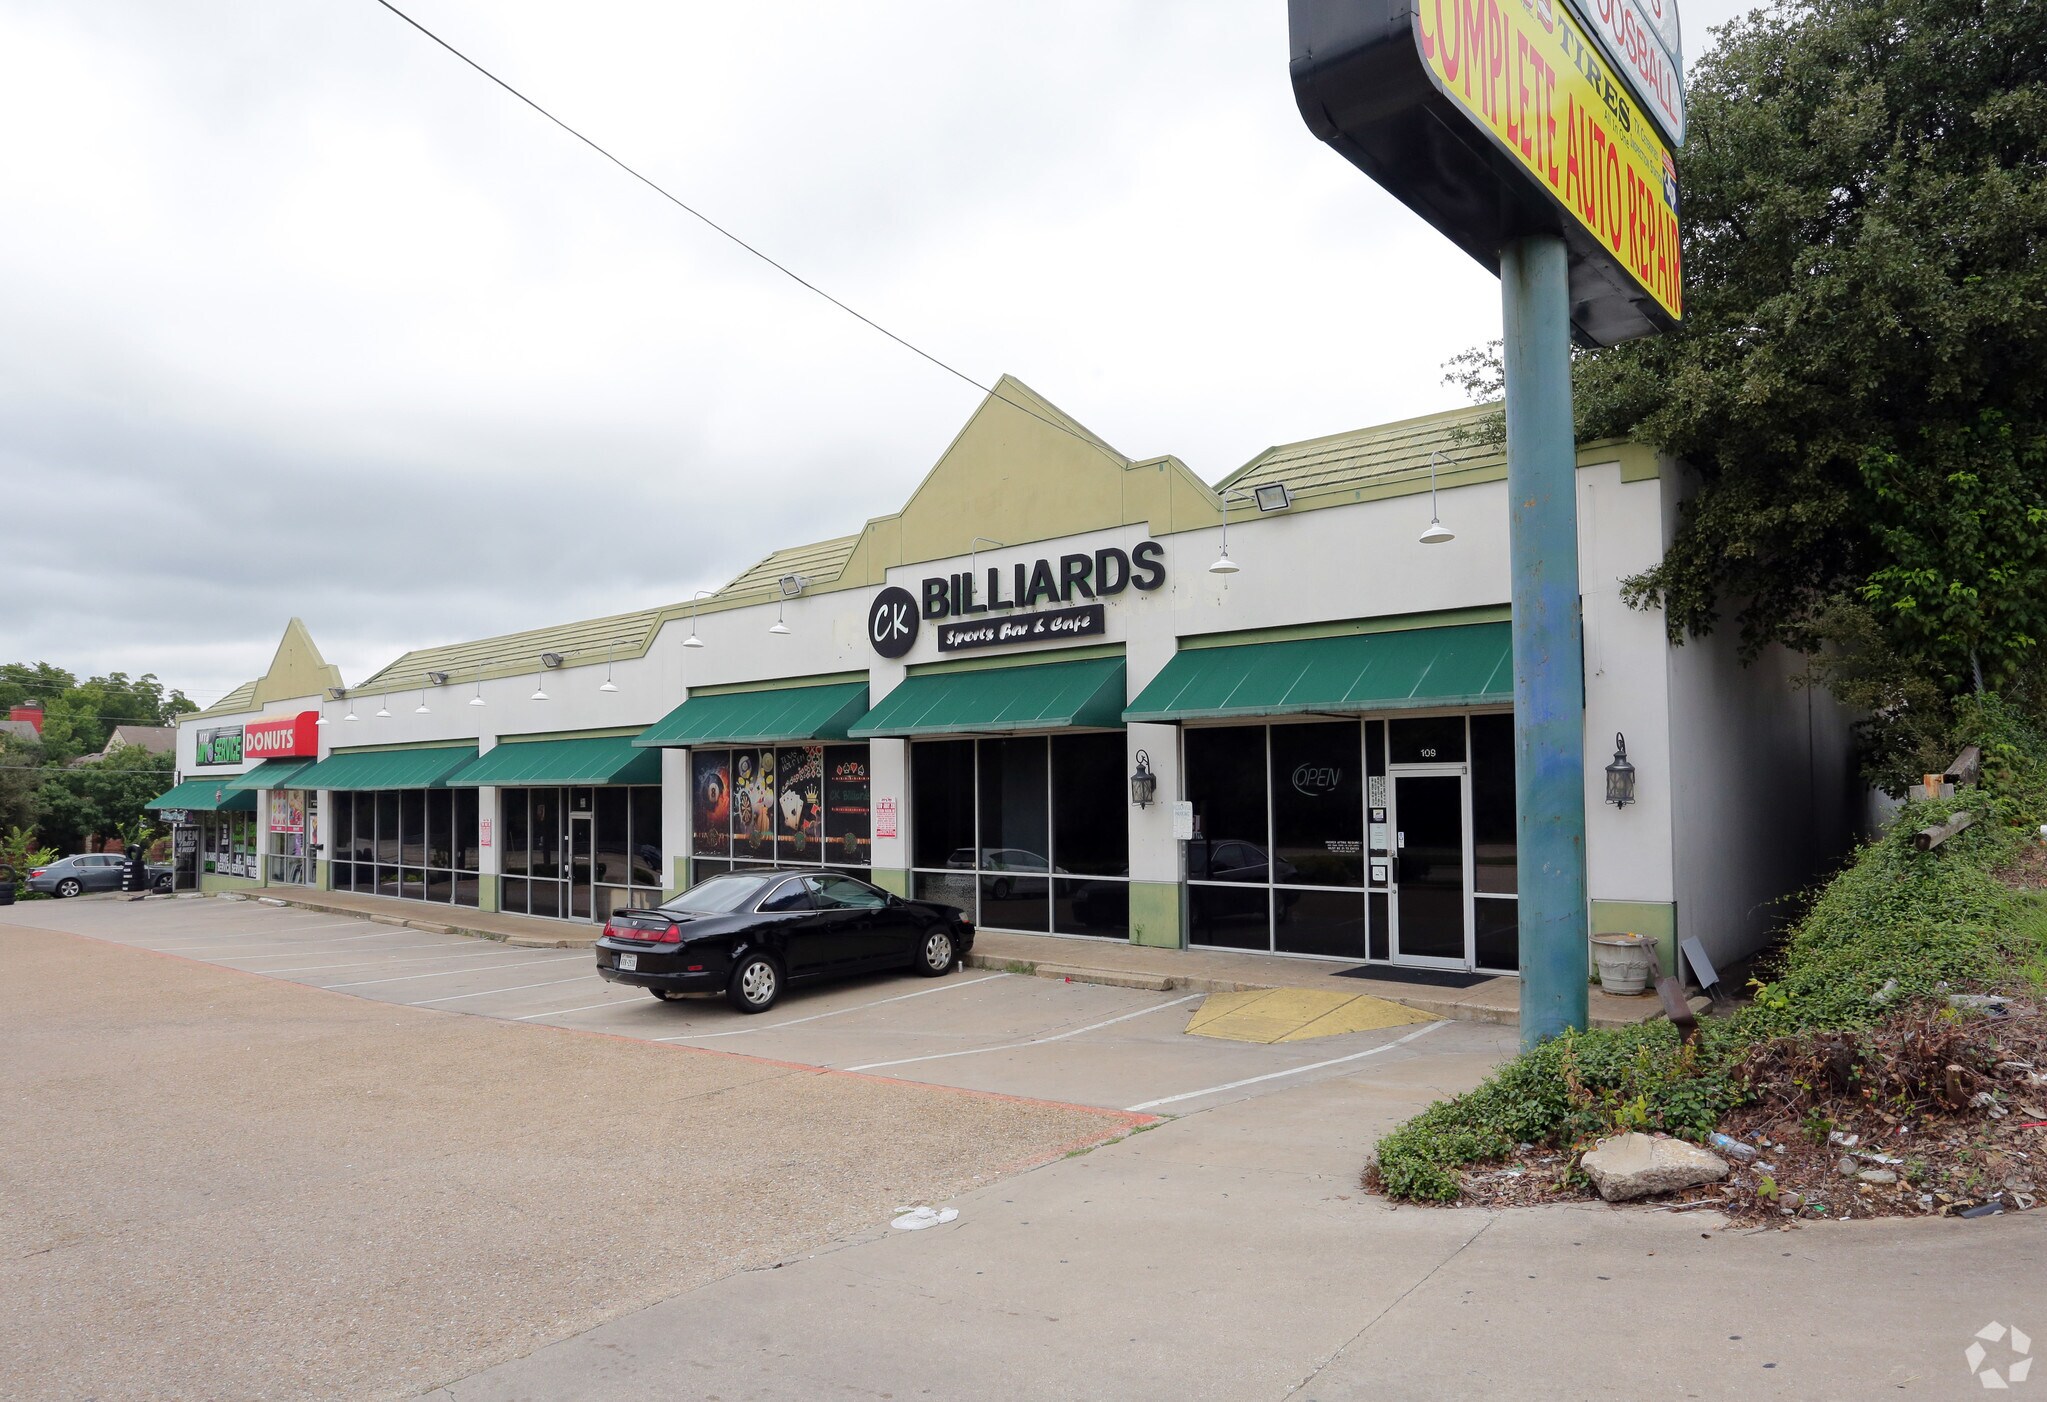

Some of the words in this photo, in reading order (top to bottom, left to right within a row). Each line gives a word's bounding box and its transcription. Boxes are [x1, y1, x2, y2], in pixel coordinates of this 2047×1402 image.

[1558, 14, 1631, 133] TIRES
[1566, 92, 1623, 253] AUTO
[1627, 162, 1683, 315] REPAIR
[922, 541, 1166, 621] BILLIARDS
[873, 602, 909, 643] CK
[946, 627, 995, 646] Sports
[999, 622, 1028, 640] Bar
[1033, 617, 1045, 633] &
[214, 736, 242, 762] SERVICE
[246, 729, 294, 751] DONUTS
[1421, 748, 1436, 757] 109
[1297, 767, 1341, 787] OPEN
[176, 830, 198, 841] OPEN
